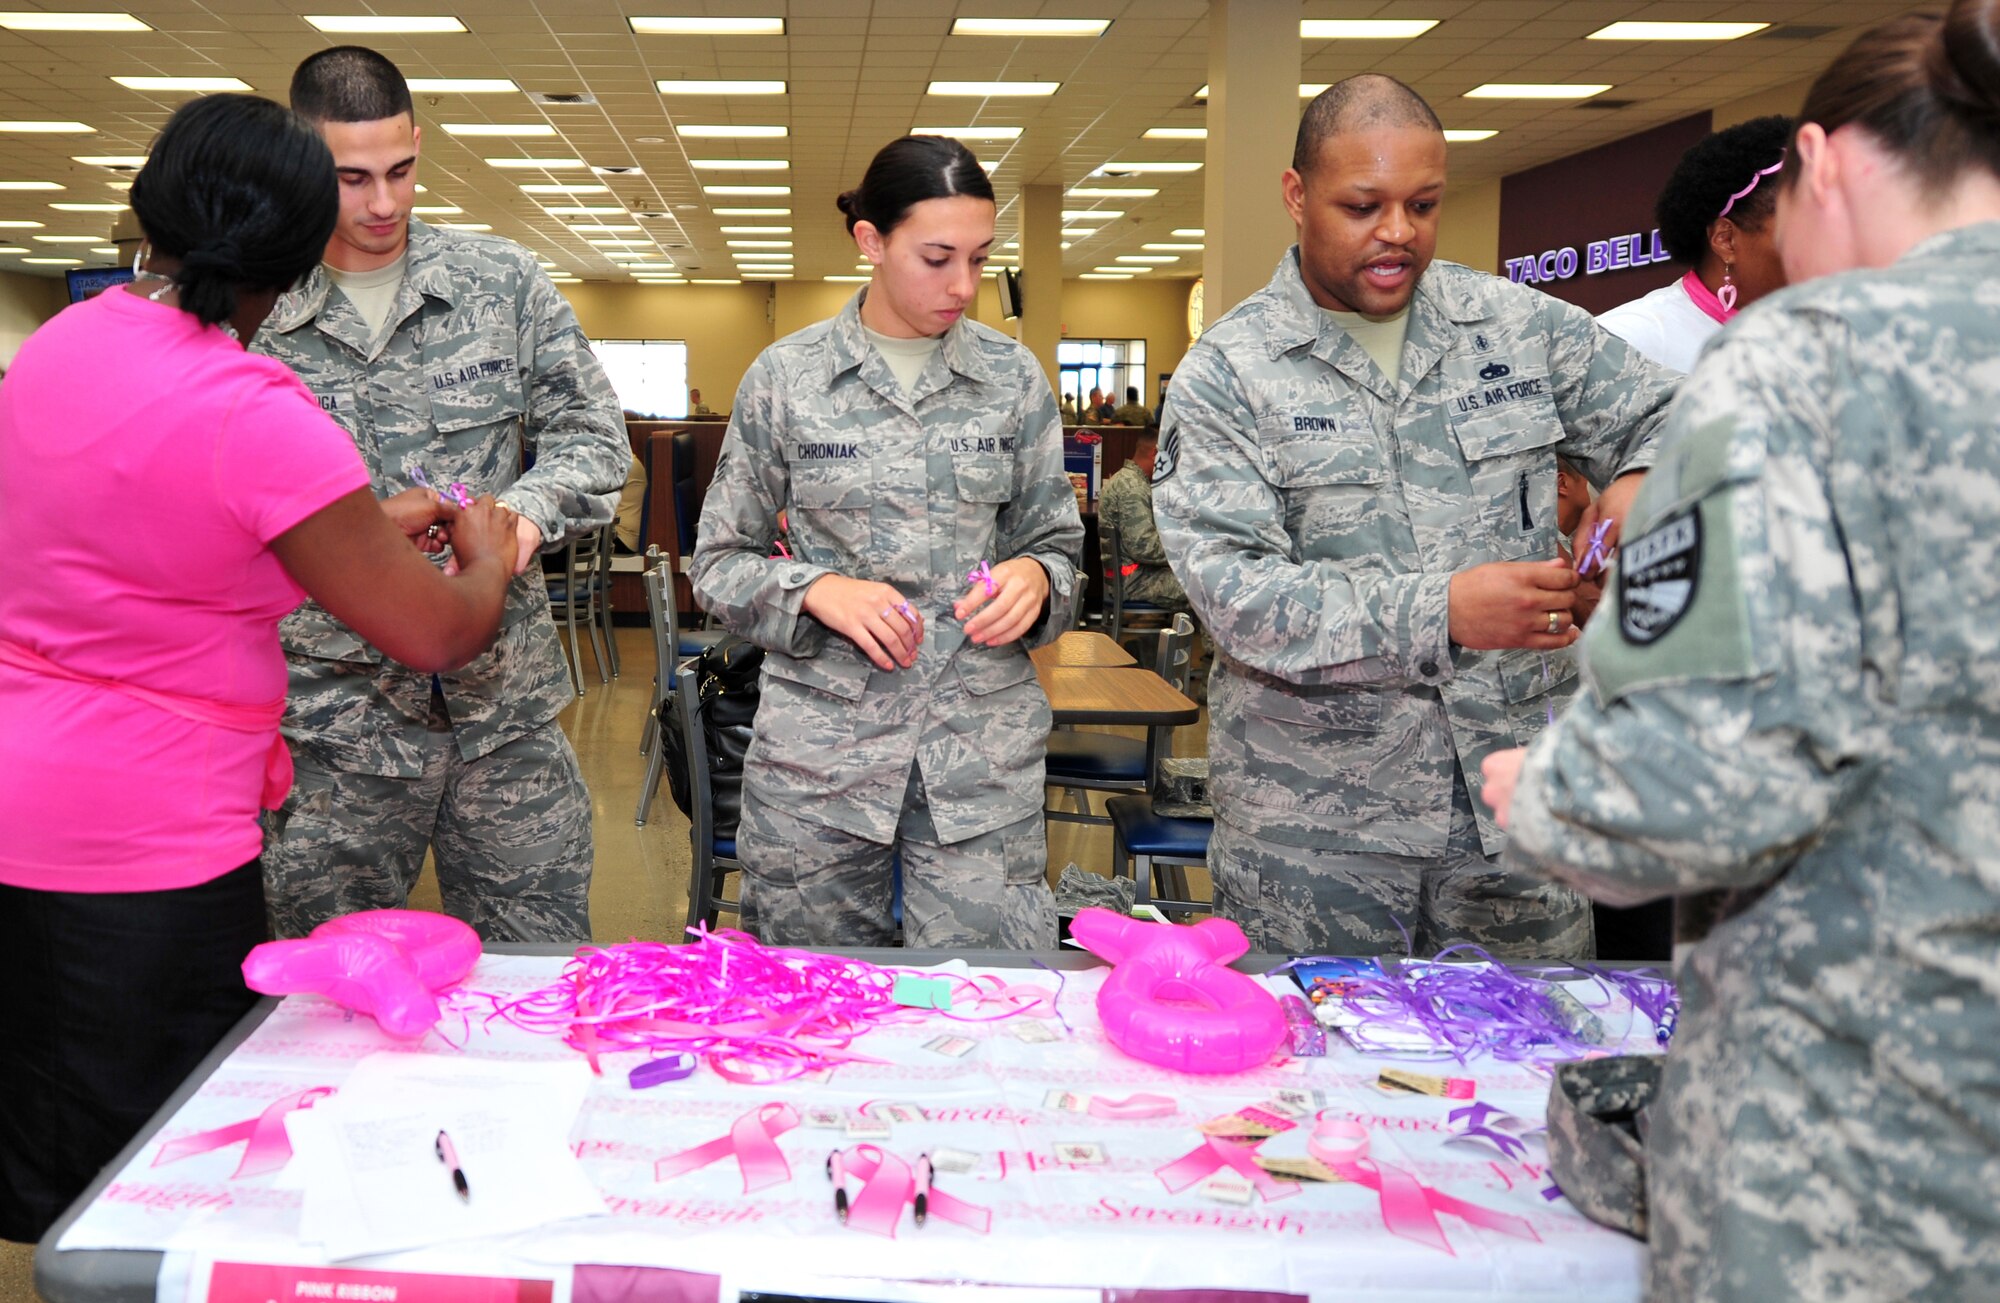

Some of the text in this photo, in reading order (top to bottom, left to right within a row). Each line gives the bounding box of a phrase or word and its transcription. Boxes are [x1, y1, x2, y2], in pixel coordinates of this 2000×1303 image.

[1505, 229, 1671, 283] TACO BELL
[433, 357, 514, 389] U.S. AIR FORCE
[1458, 378, 1544, 412] U.S. AIR FORCE
[1294, 416, 1337, 432] BROWN
[798, 442, 858, 459] CHRONIAK
[950, 438, 973, 453] U.S.
[977, 437, 996, 452] AIR
[1088, 1198, 1304, 1235] Strength
[295, 1280, 398, 1302] PINK RIBBON
